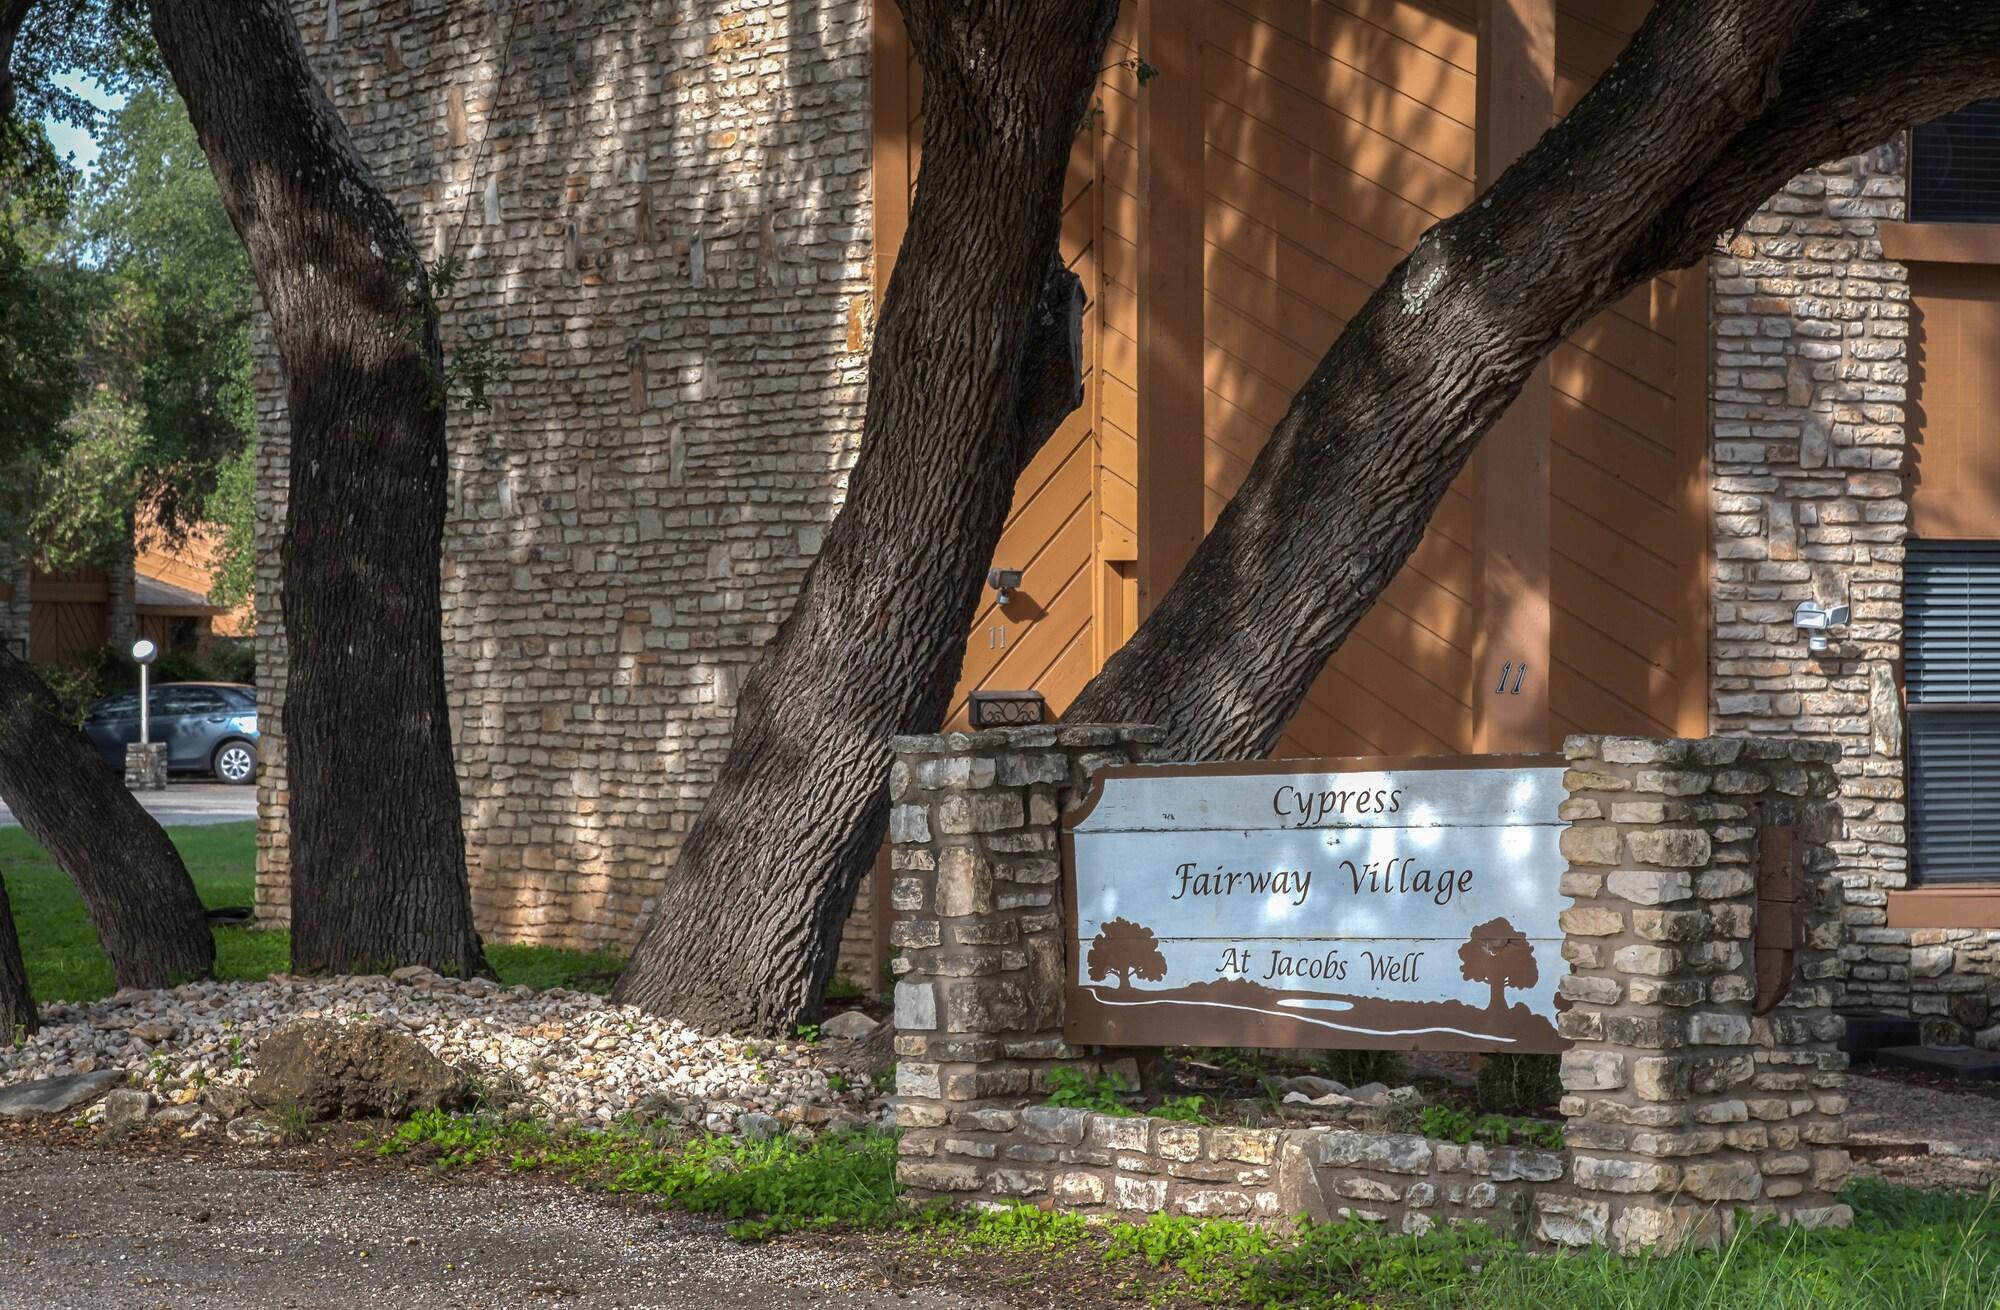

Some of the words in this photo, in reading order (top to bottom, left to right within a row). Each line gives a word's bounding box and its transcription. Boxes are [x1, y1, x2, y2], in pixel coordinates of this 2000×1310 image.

[989, 625, 1005, 649] 11
[1495, 660, 1527, 695] 11
[1273, 785, 1403, 827] Cypress
[1171, 862, 1312, 906] Fairway
[1339, 858, 1474, 905] Village
[1216, 948, 1250, 974] At
[1263, 949, 1349, 981] Jacobs
[1360, 952, 1424, 983] Well
